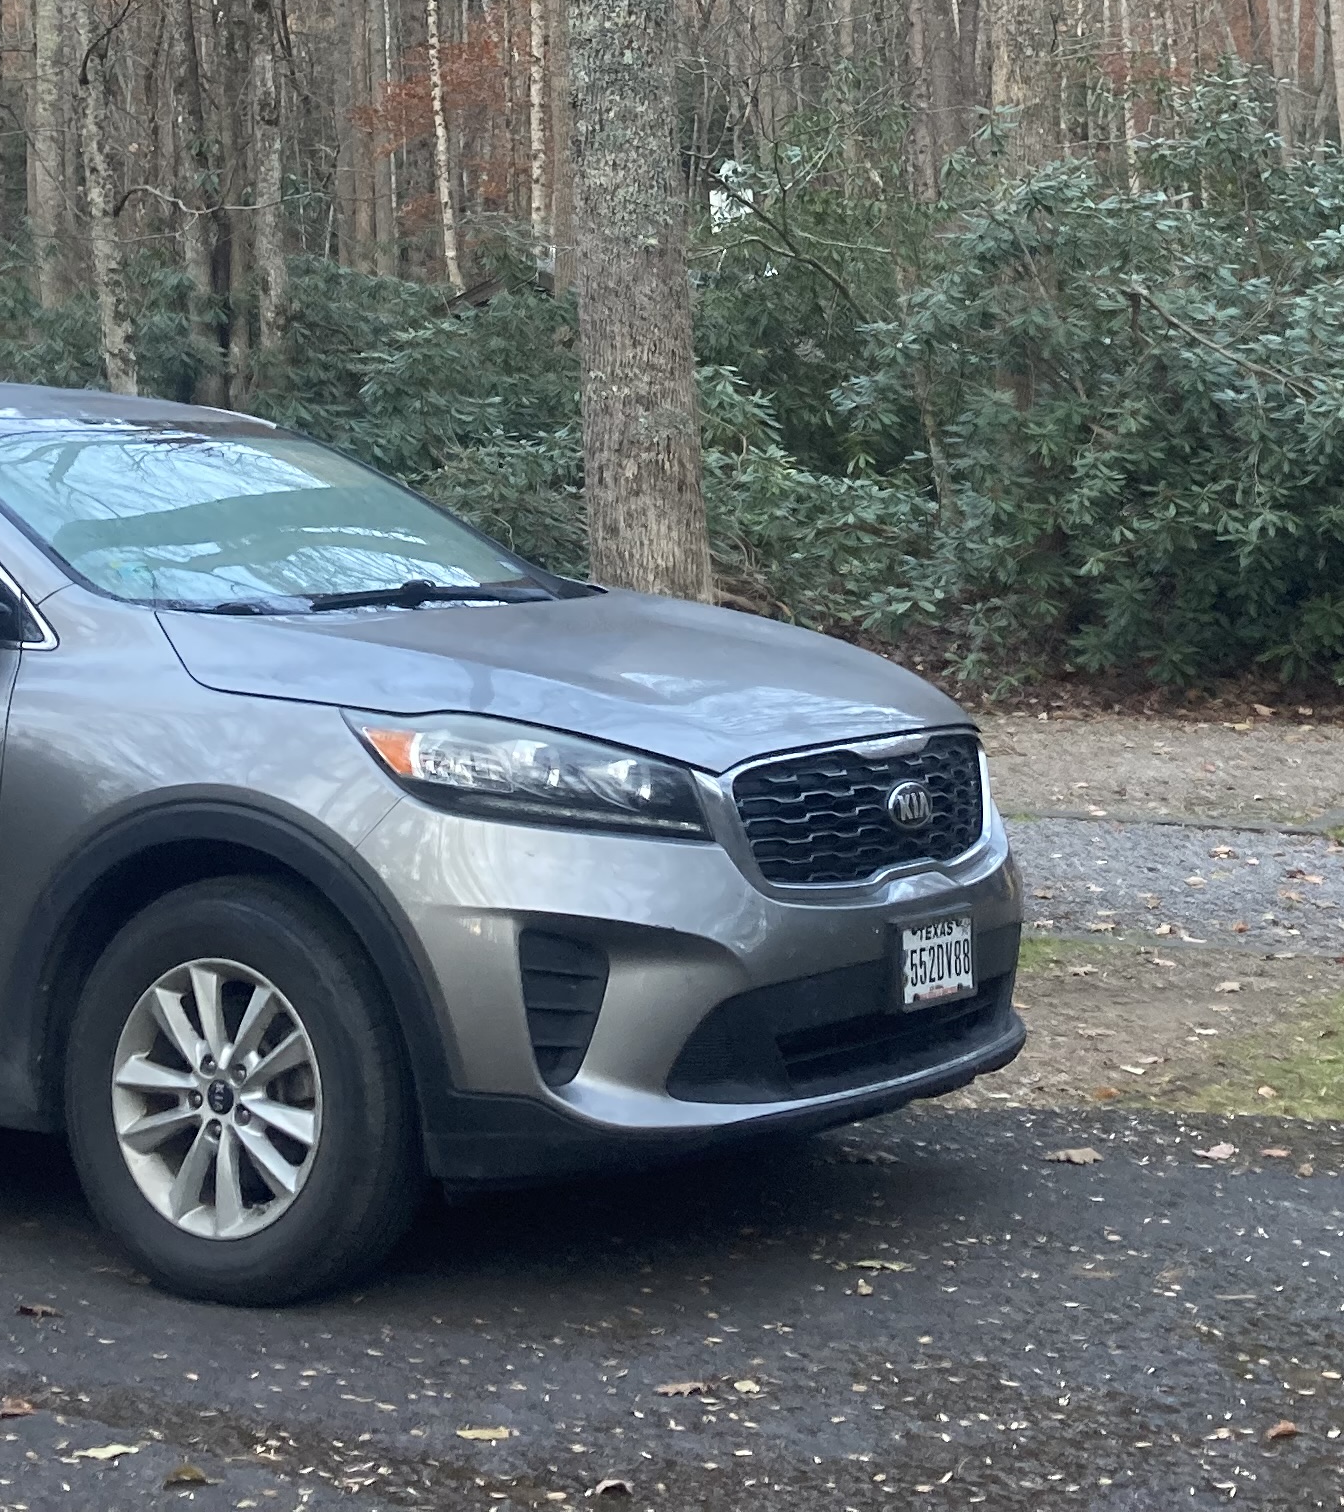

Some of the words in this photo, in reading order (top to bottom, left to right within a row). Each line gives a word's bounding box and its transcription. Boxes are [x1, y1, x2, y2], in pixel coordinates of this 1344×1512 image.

[898, 791, 929, 821] KIA
[918, 921, 953, 941] TEXAS
[910, 939, 970, 987] 552DV88
